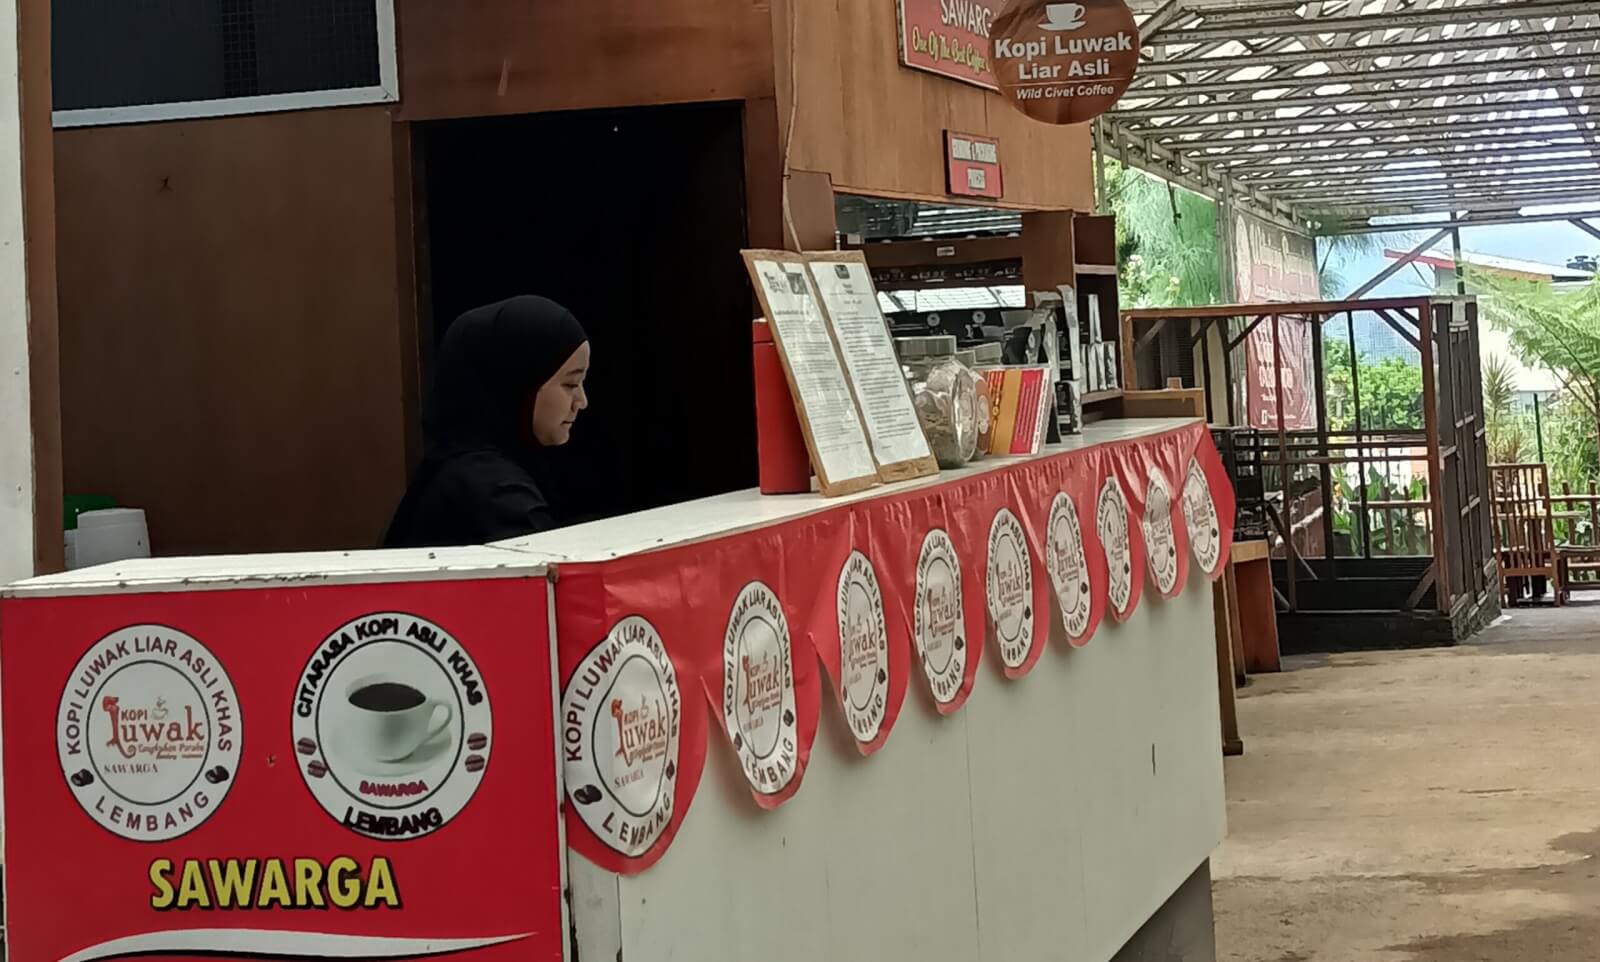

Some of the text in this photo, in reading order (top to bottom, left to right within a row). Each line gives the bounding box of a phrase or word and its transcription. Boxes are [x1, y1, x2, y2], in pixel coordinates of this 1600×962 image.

[995, 32, 1132, 61] Kopi Luwak
[1019, 59, 1109, 80] Liar Asli
[1016, 85, 1114, 100] Wild Civet Coffee
[749, 588, 766, 607] LIAR
[727, 598, 748, 654] LUWAK
[297, 618, 483, 718] CITARASA KOPI ASLI KHAS
[66, 636, 233, 755] KOPI LUWAK LIAR ASLI KHAS
[566, 702, 585, 762] KOPI
[576, 633, 623, 701] LUWAK
[623, 624, 645, 645] LIAR
[726, 662, 735, 716] KOPI
[121, 709, 148, 721] KOPI
[104, 763, 159, 774] SAWARGA
[359, 780, 429, 797] SAWARGA
[95, 791, 209, 832] LEMBANG
[343, 806, 443, 836] LEMBANG
[602, 792, 671, 846] LEMBANG
[150, 857, 401, 909] SAWARGA
